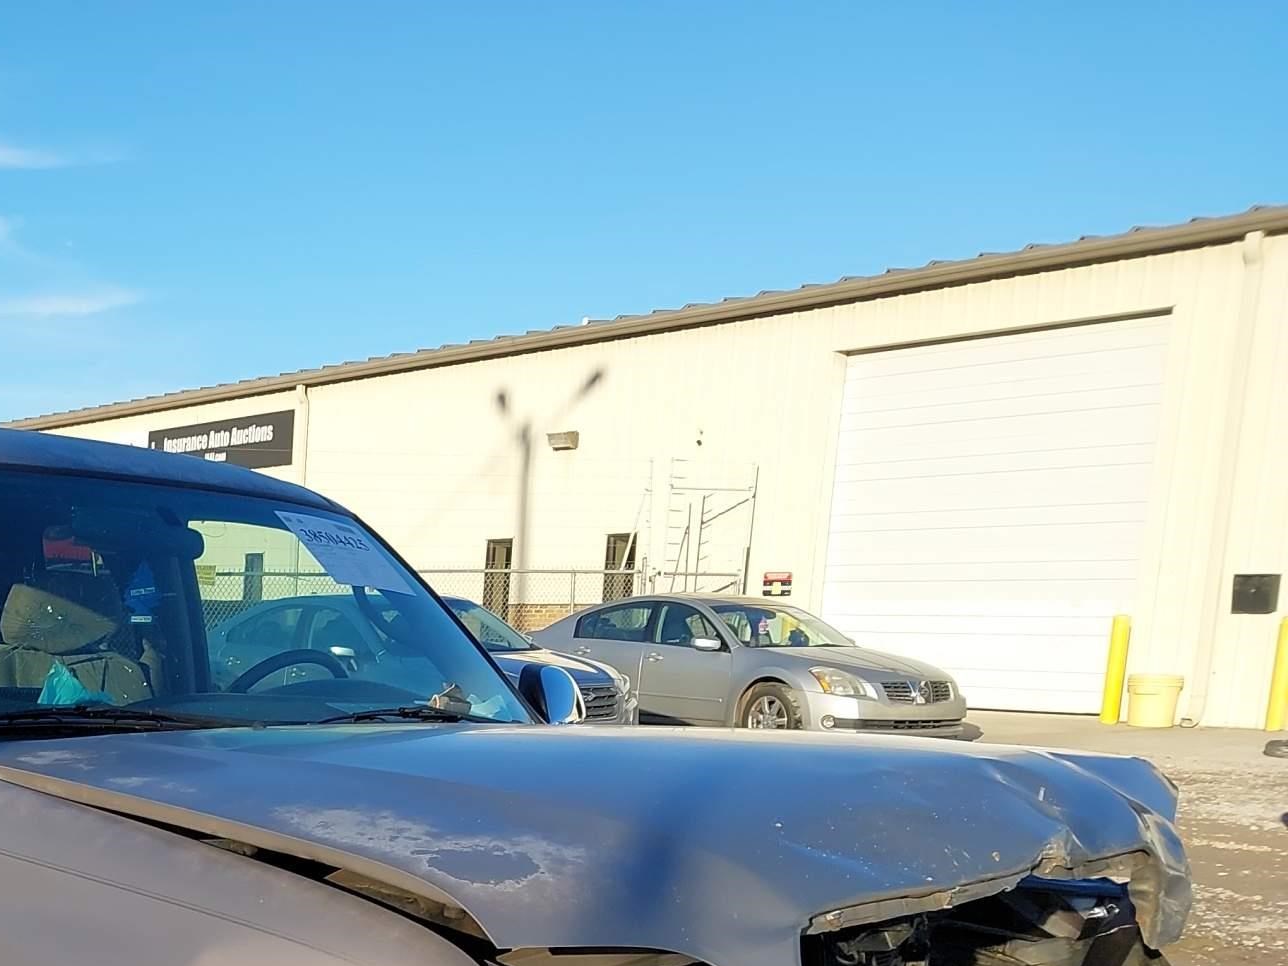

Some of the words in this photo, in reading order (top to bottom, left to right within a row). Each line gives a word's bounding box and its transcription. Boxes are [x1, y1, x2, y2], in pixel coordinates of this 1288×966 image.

[164, 433, 208, 453] Insurance
[208, 430, 230, 449] Auto
[231, 424, 273, 446] Auctions
